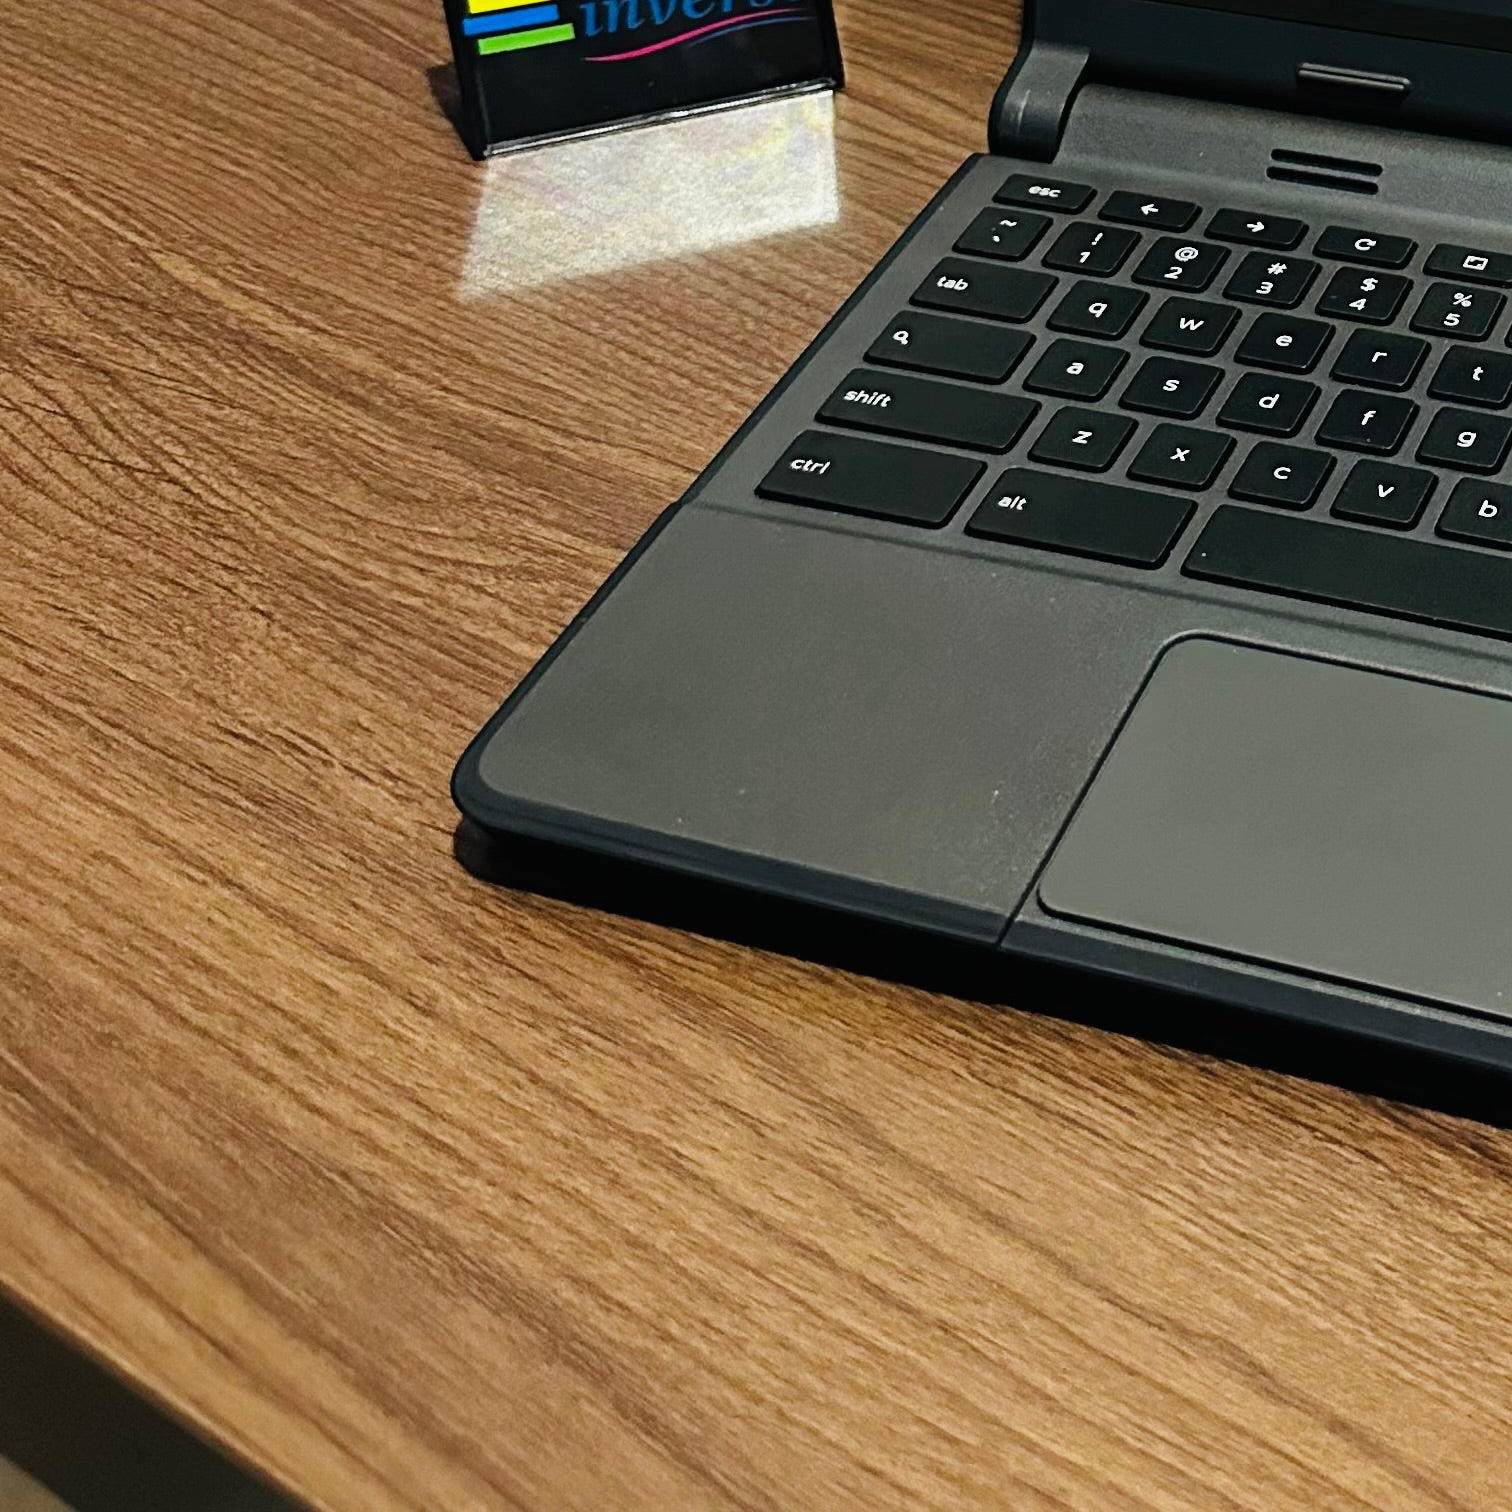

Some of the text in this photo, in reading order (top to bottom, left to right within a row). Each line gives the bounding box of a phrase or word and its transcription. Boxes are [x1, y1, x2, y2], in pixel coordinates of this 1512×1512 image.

[1028, 185, 1061, 198] esc
[1079, 251, 1091, 264] 1
[1164, 266, 1183, 280] 2
[936, 276, 969, 291] tab
[1255, 281, 1274, 295] 3
[1088, 302, 1108, 318] q
[1348, 298, 1367, 311] 4
[1179, 317, 1205, 331] w
[1443, 312, 1461, 327] 5
[1275, 335, 1293, 347] e
[1371, 351, 1388, 363] r
[1066, 362, 1084, 375] a
[1472, 366, 1484, 382] t
[1162, 379, 1180, 392] s
[843, 390, 891, 408] shift
[1258, 393, 1280, 409] d
[1361, 410, 1377, 426] f
[1071, 430, 1093, 444] z
[1456, 431, 1477, 448] g
[1170, 447, 1190, 462] x
[790, 459, 831, 475] ctrl
[1273, 466, 1292, 480] c
[1378, 484, 1395, 498] v
[997, 495, 1027, 511] alt
[1478, 499, 1498, 518] b
